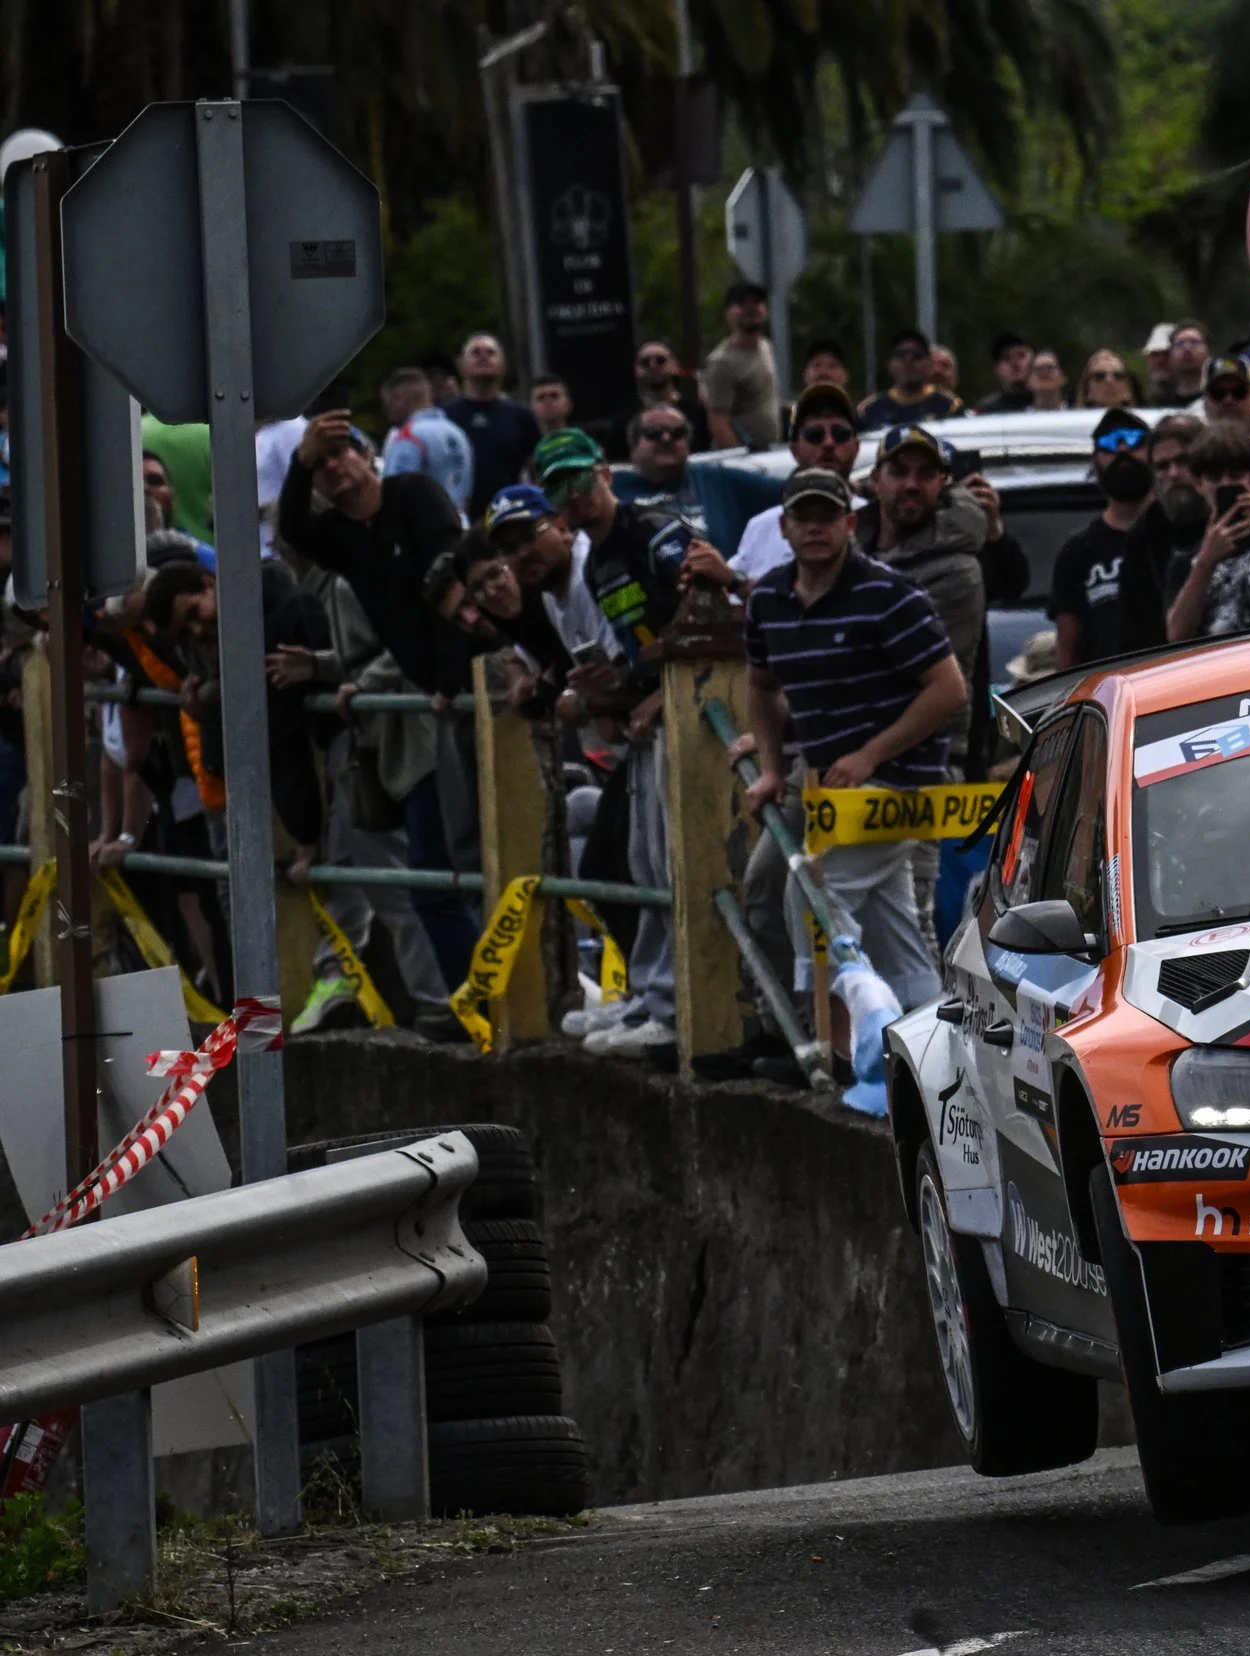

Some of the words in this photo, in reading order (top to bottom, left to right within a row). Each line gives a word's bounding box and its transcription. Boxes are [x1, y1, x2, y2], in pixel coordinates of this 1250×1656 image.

[862, 796, 935, 830] ZONA
[1106, 1104, 1144, 1129] MS
[963, 1143, 980, 1165] Hus
